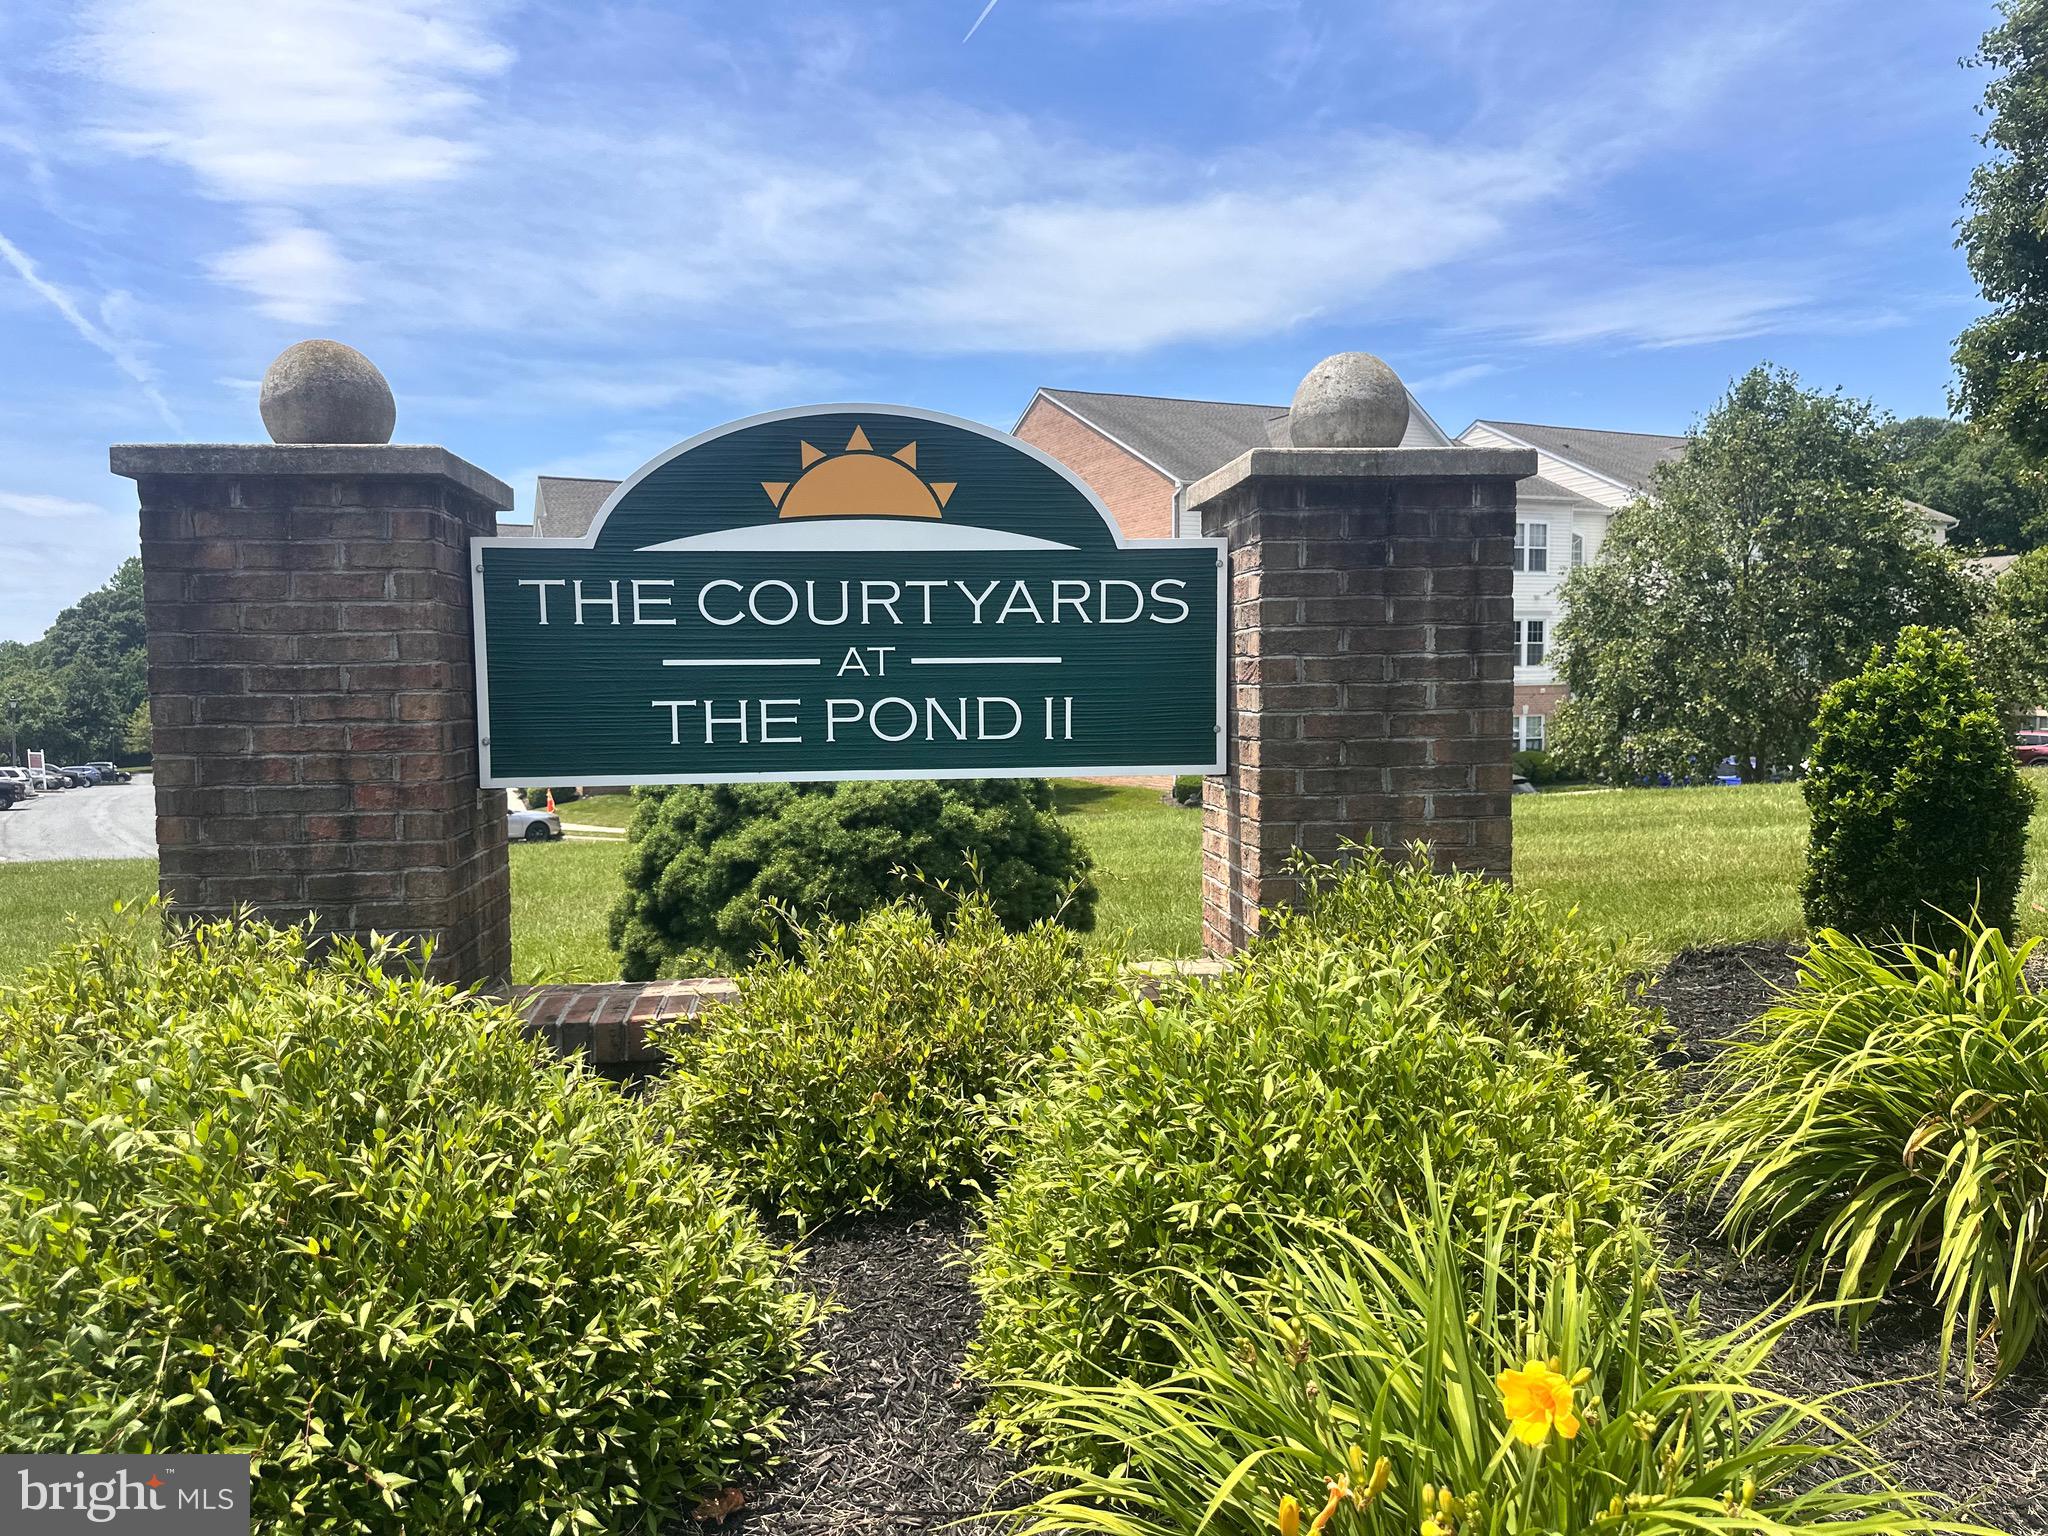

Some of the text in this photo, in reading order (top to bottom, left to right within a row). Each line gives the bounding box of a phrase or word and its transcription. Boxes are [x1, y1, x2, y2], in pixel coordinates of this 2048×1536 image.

[518, 578, 1190, 626] THE COURTYARDS
[836, 646, 897, 677] AT
[651, 696, 1073, 745] THE POND II
